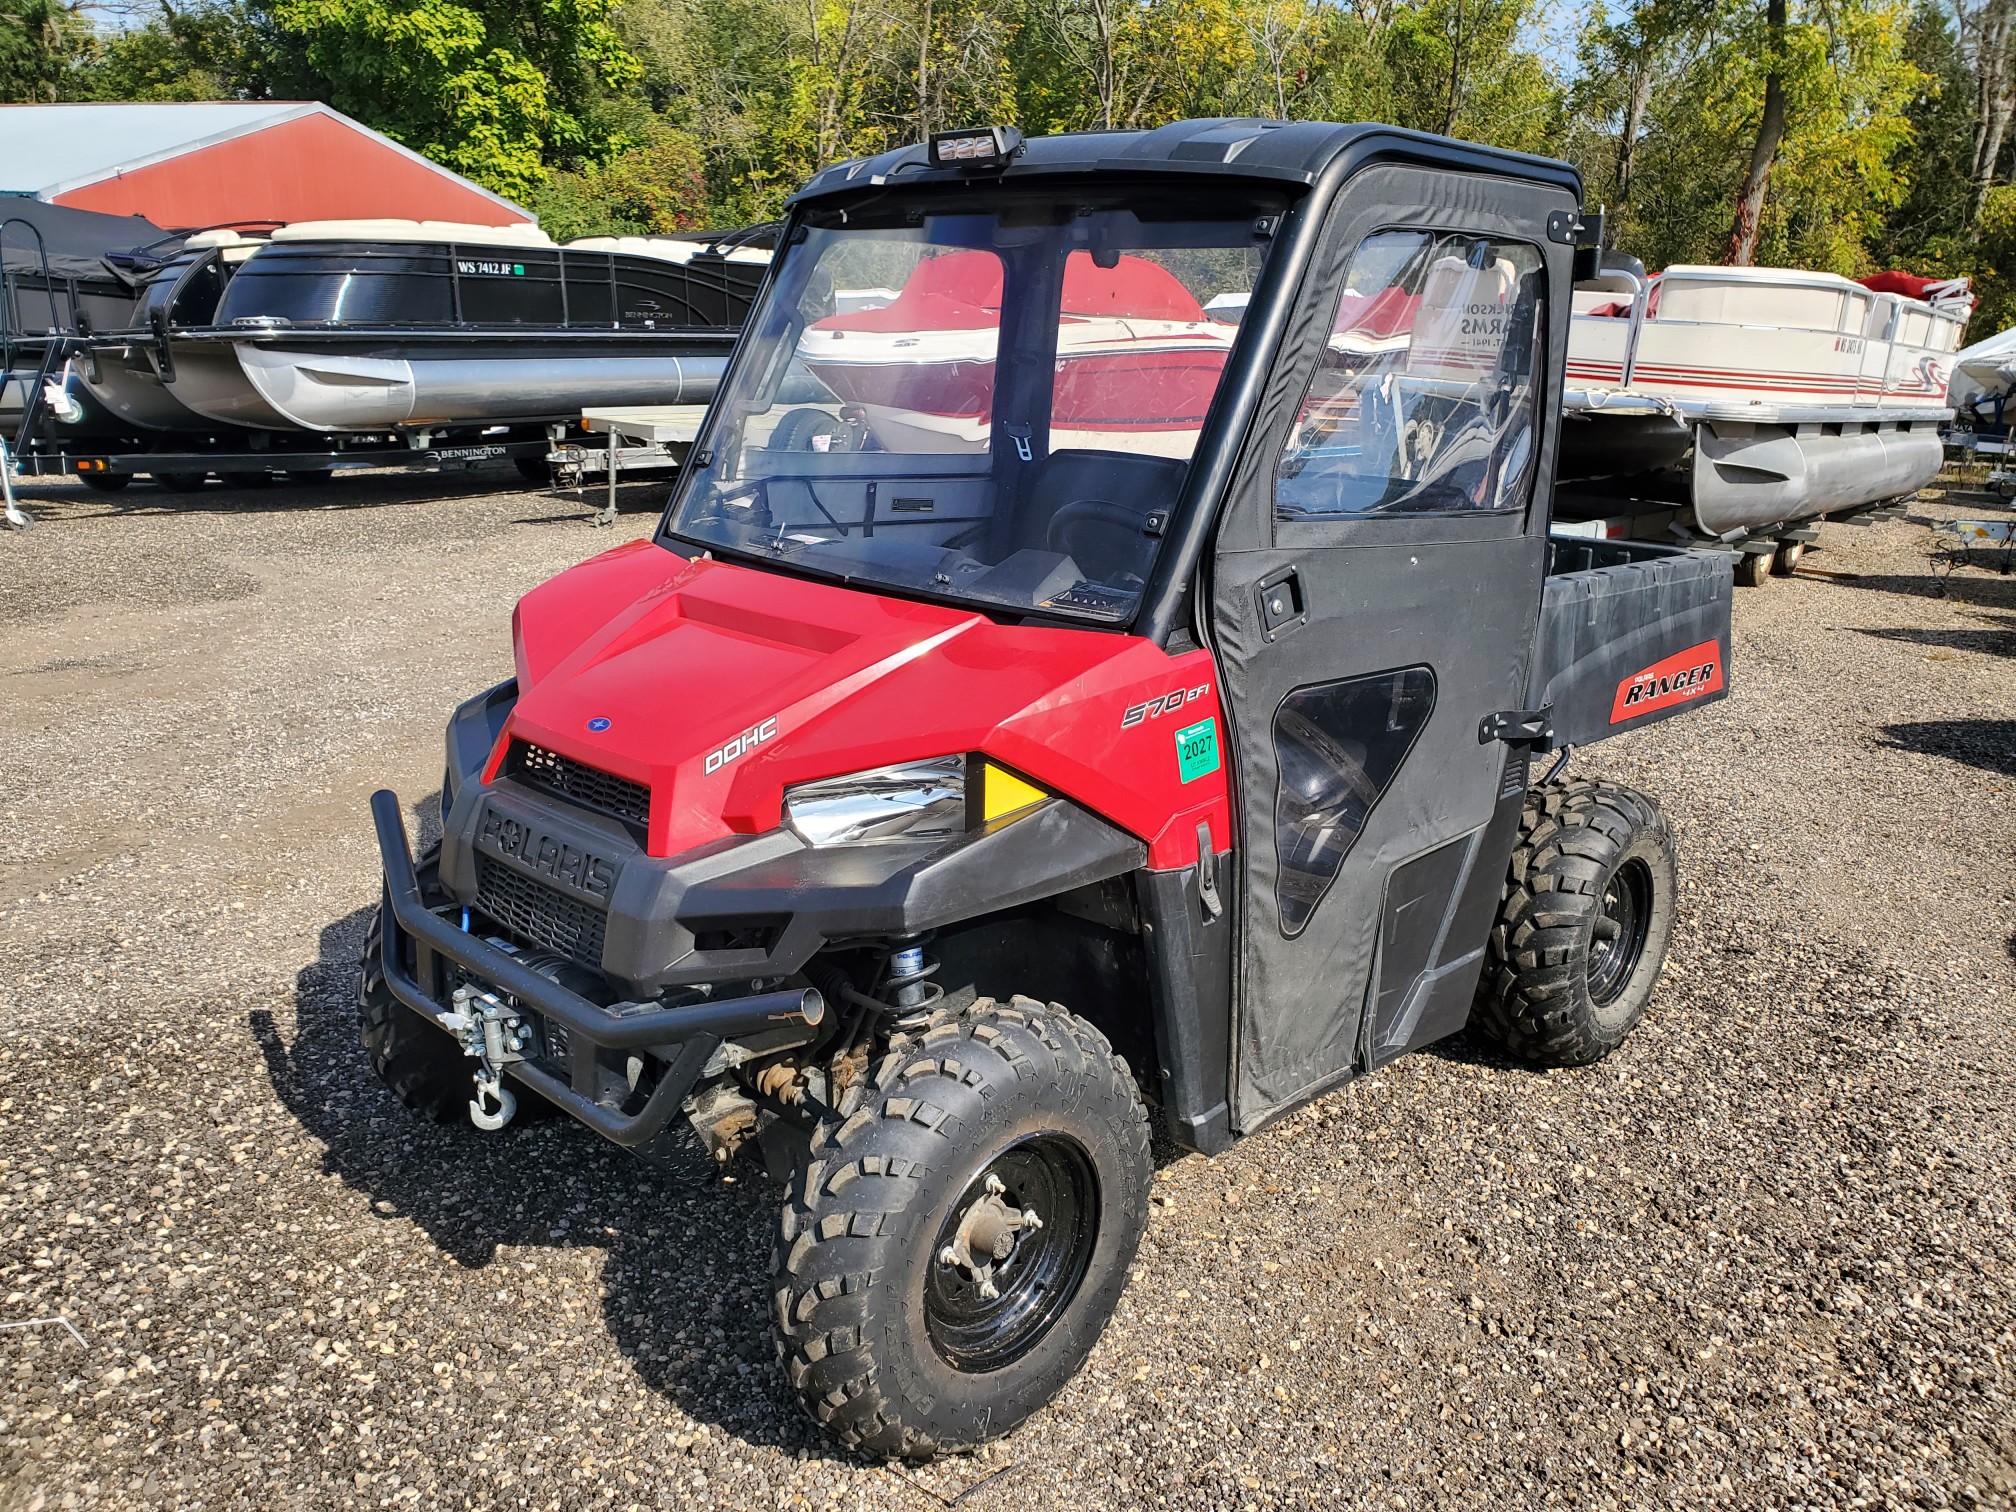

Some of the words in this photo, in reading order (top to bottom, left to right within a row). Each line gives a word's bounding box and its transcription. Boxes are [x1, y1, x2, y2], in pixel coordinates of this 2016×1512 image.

[457, 261, 476, 273] WS
[476, 262, 500, 274] 7412
[501, 263, 512, 275] JF
[441, 446, 507, 459] BENNINGTON
[1622, 661, 1715, 708] RANGER
[1120, 687, 1186, 730] 570
[1185, 683, 1210, 702] EFI
[703, 714, 778, 777] DOHC
[1183, 735, 1212, 761] 2027
[479, 807, 617, 901] POLARIS
[896, 951, 922, 960] POLAR
